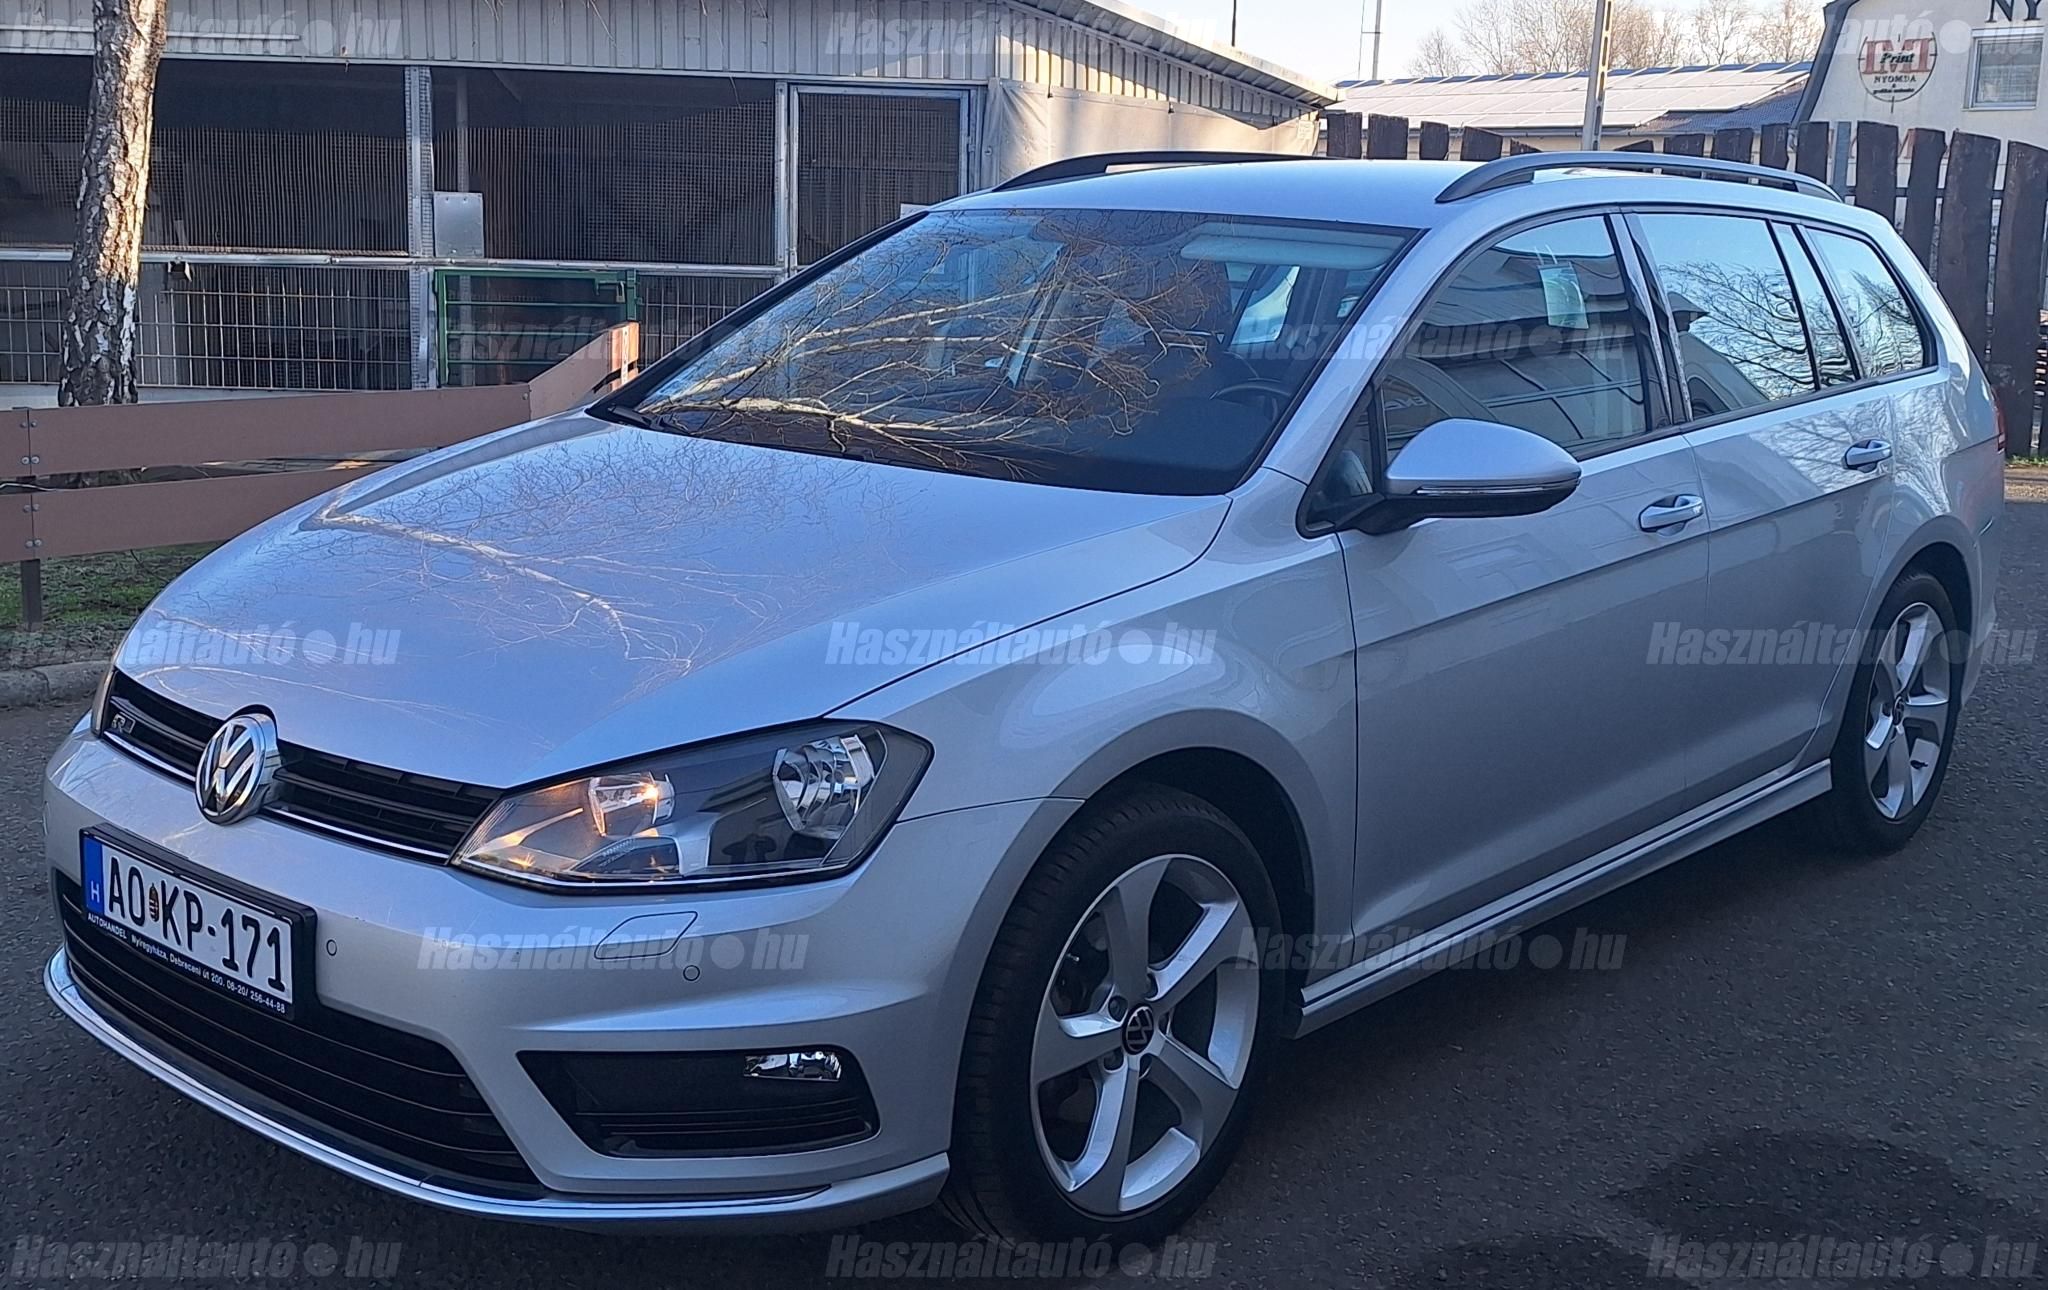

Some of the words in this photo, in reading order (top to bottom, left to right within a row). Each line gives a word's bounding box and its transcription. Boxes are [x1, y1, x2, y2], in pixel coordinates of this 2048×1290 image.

[1880, 52, 1915, 64] Print
[1873, 74, 1917, 84] NYOMDA
[90, 880, 100, 903] H
[88, 913, 127, 939] AUTOHANDEL
